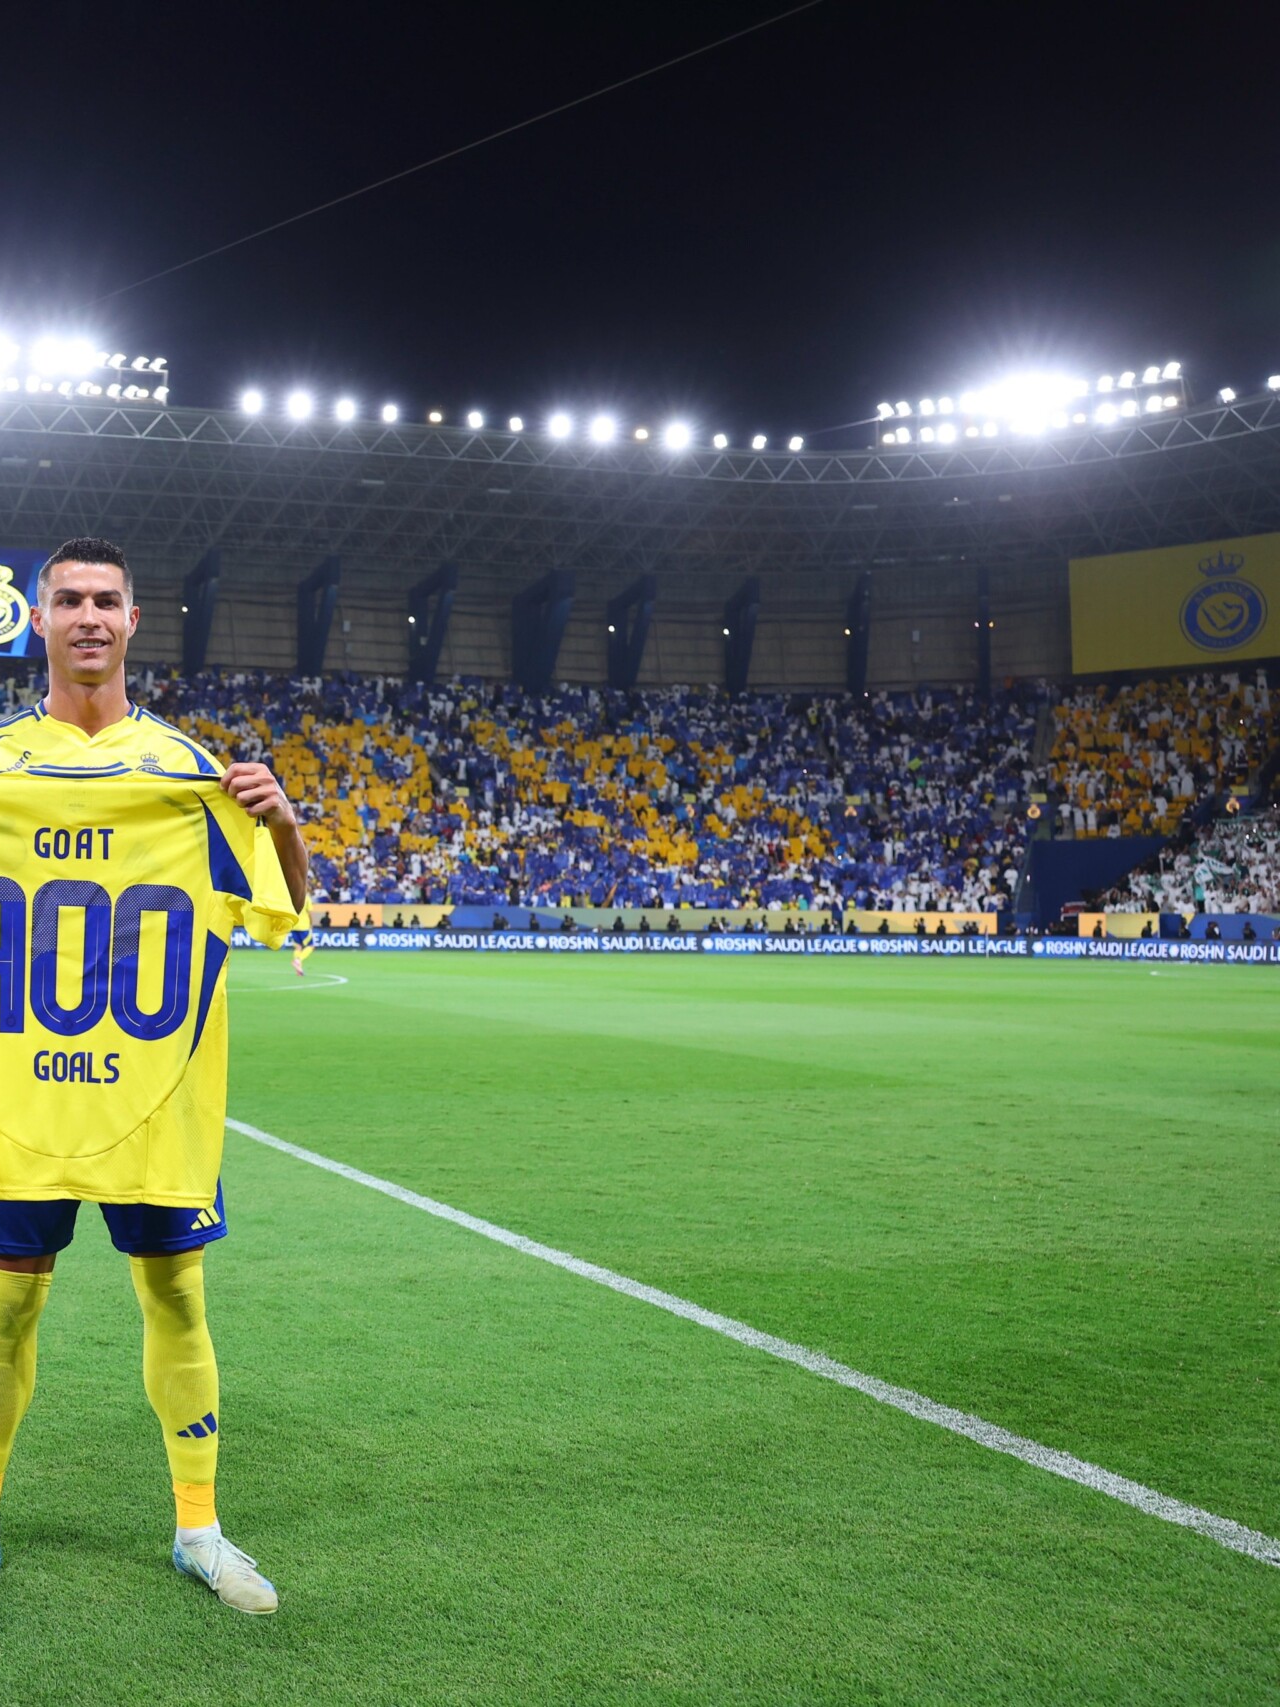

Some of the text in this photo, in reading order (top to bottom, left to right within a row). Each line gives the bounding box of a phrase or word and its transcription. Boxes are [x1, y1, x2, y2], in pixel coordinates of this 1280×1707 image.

[34, 827, 114, 860] GOAT
[312, 932, 360, 948] EAGUE
[378, 933, 535, 949] ROSHN SAUDI LEAGUE
[548, 935, 698, 951] ROSHN SAUDI LEAGUE
[714, 937, 857, 953] ROSHN SAUDI LEAGUE
[870, 939, 1027, 954] ROSHN SAUDI LEAGUE
[1046, 941, 1168, 958] ROSHN SAUDI LEAGUE
[1180, 944, 1225, 959] ROSHN
[1227, 945, 1267, 961] SAUDI
[33, 1050, 120, 1084] GOALS
